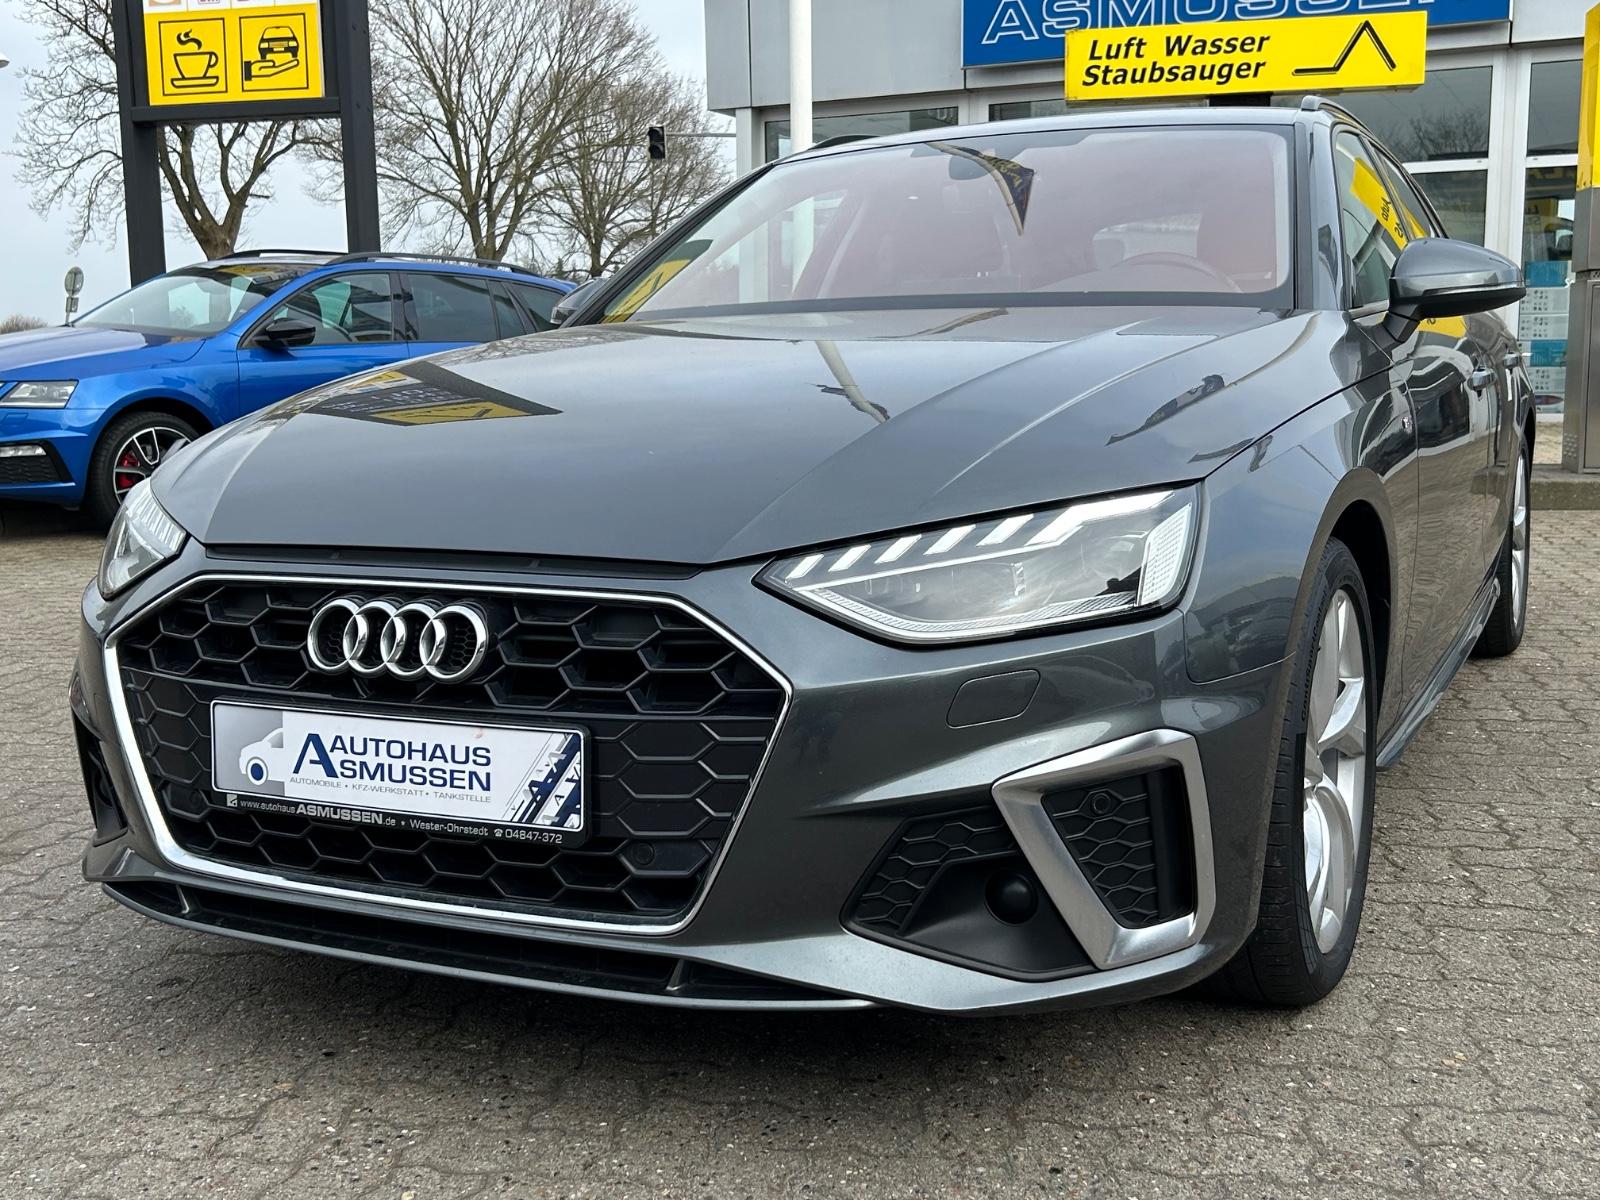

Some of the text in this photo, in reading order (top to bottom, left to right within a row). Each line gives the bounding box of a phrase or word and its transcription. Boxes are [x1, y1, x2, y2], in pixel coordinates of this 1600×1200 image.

[981, 0, 1435, 45] ASMU
[1088, 34, 1271, 61] Luft Wasser
[1082, 61, 1267, 87] Staubsauger
[292, 732, 492, 792] ASMUSSEN
[329, 734, 492, 767] AUTOHAUS
[289, 777, 492, 803] AUTOMOBILE KFZ-WERKSTATT TANKSTELLE
[409, 818, 489, 837] Wester-Ohrstedt
[505, 828, 563, 844] 04847-372
